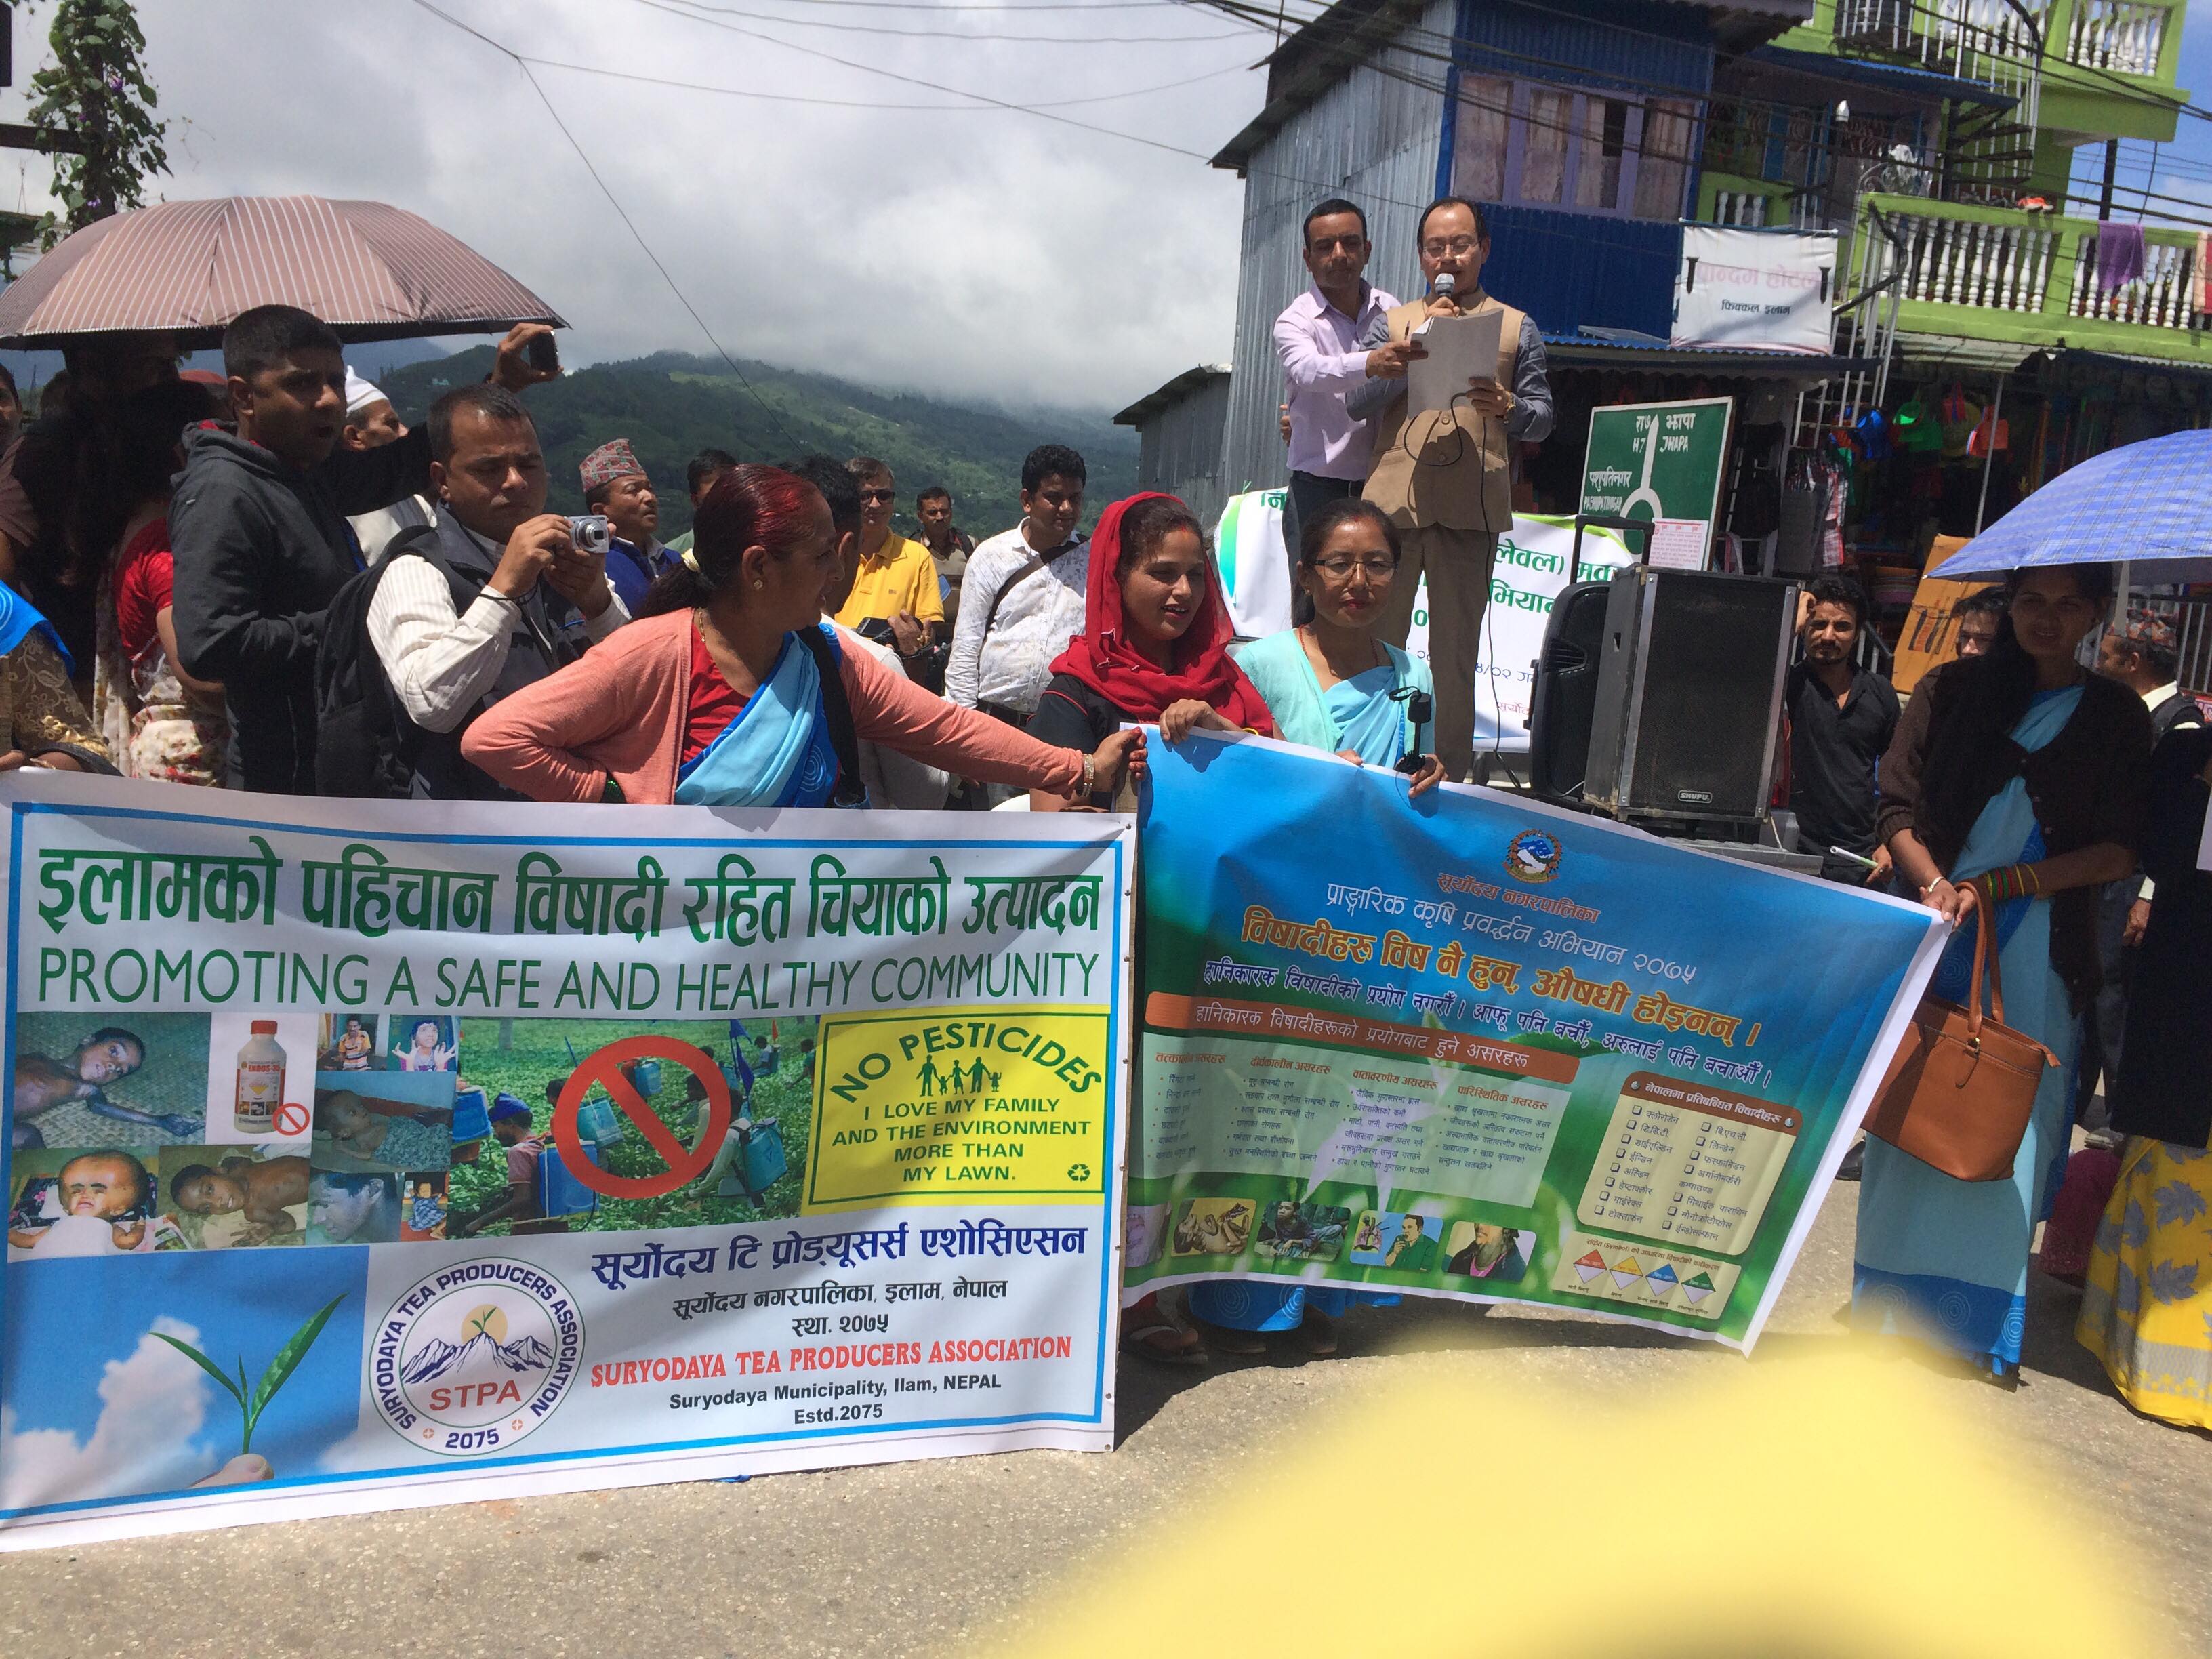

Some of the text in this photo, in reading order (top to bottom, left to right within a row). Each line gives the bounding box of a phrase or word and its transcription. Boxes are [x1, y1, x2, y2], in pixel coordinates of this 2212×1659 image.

[1665, 413, 1696, 430] झापा
[1660, 435, 1689, 453] JHAPA
[1589, 466, 1633, 492] पशुपतिनगर
[39, 835, 1103, 946] इलामको पहिचान विषादी रहित चियाको उत्पादन
[1437, 872, 1601, 924] सूर्योदय नगरपालिका
[1414, 900, 1458, 928] कृषि
[1539, 930, 1627, 965] अभियान
[1633, 954, 1696, 985] २०७५
[39, 948, 1099, 1012] PROMOTING A SAFE AND HEALTHY COMMUNITY
[1380, 929, 1432, 972] विष
[1436, 940, 1466, 978] नै
[1632, 990, 1742, 1048] होइनन्
[1196, 1001, 1263, 1026] हानिकारक
[1270, 1007, 1359, 1039] विषादीहरूको
[1366, 1025, 1430, 1050] प्रयोगबाट
[1435, 1036, 1460, 1058] हुने
[1203, 956, 1279, 987] हानिकारक
[1284, 964, 1362, 1001] विषादीको
[1366, 983, 1407, 1009] प्रयोग
[1473, 1004, 1511, 1032] आफू
[1517, 1009, 1550, 1034] पनि
[1667, 1045, 1700, 1070] पनि
[830, 1022, 1102, 1103] NO PESTICIDES
[1353, 1069, 1401, 1084] वातावरणीय
[1645, 1082, 1685, 1100] नेपालमा
[864, 1098, 1060, 1120] I LOVE MY FAMILY
[832, 1120, 1091, 1146] AND THE ENVIRONMENT
[894, 1143, 1023, 1164] MORE THAN
[903, 1166, 1016, 1183] MY LAWN.
[591, 1242, 716, 1290] सूर्योदय
[728, 1235, 762, 1269] टि
[920, 1218, 1088, 1258] एशोसिएसन
[672, 1275, 1008, 1322] सूर्योदय नगरपालिका, इलाम, नेपाल
[792, 1313, 889, 1338] स्था. २०७५
[376, 1263, 578, 1430] SURYODAYA TEA PRODUCERS ASSOCIATION
[591, 1336, 1072, 1388] SURYODAYA TEA PRODUCERS ASSOCIATION
[429, 1380, 522, 1411] STPA
[669, 1373, 1002, 1412] Suryodaya Municipality, Ilam, NEPAL
[794, 1404, 883, 1425] Estd.2075
[445, 1428, 499, 1449] 2075
